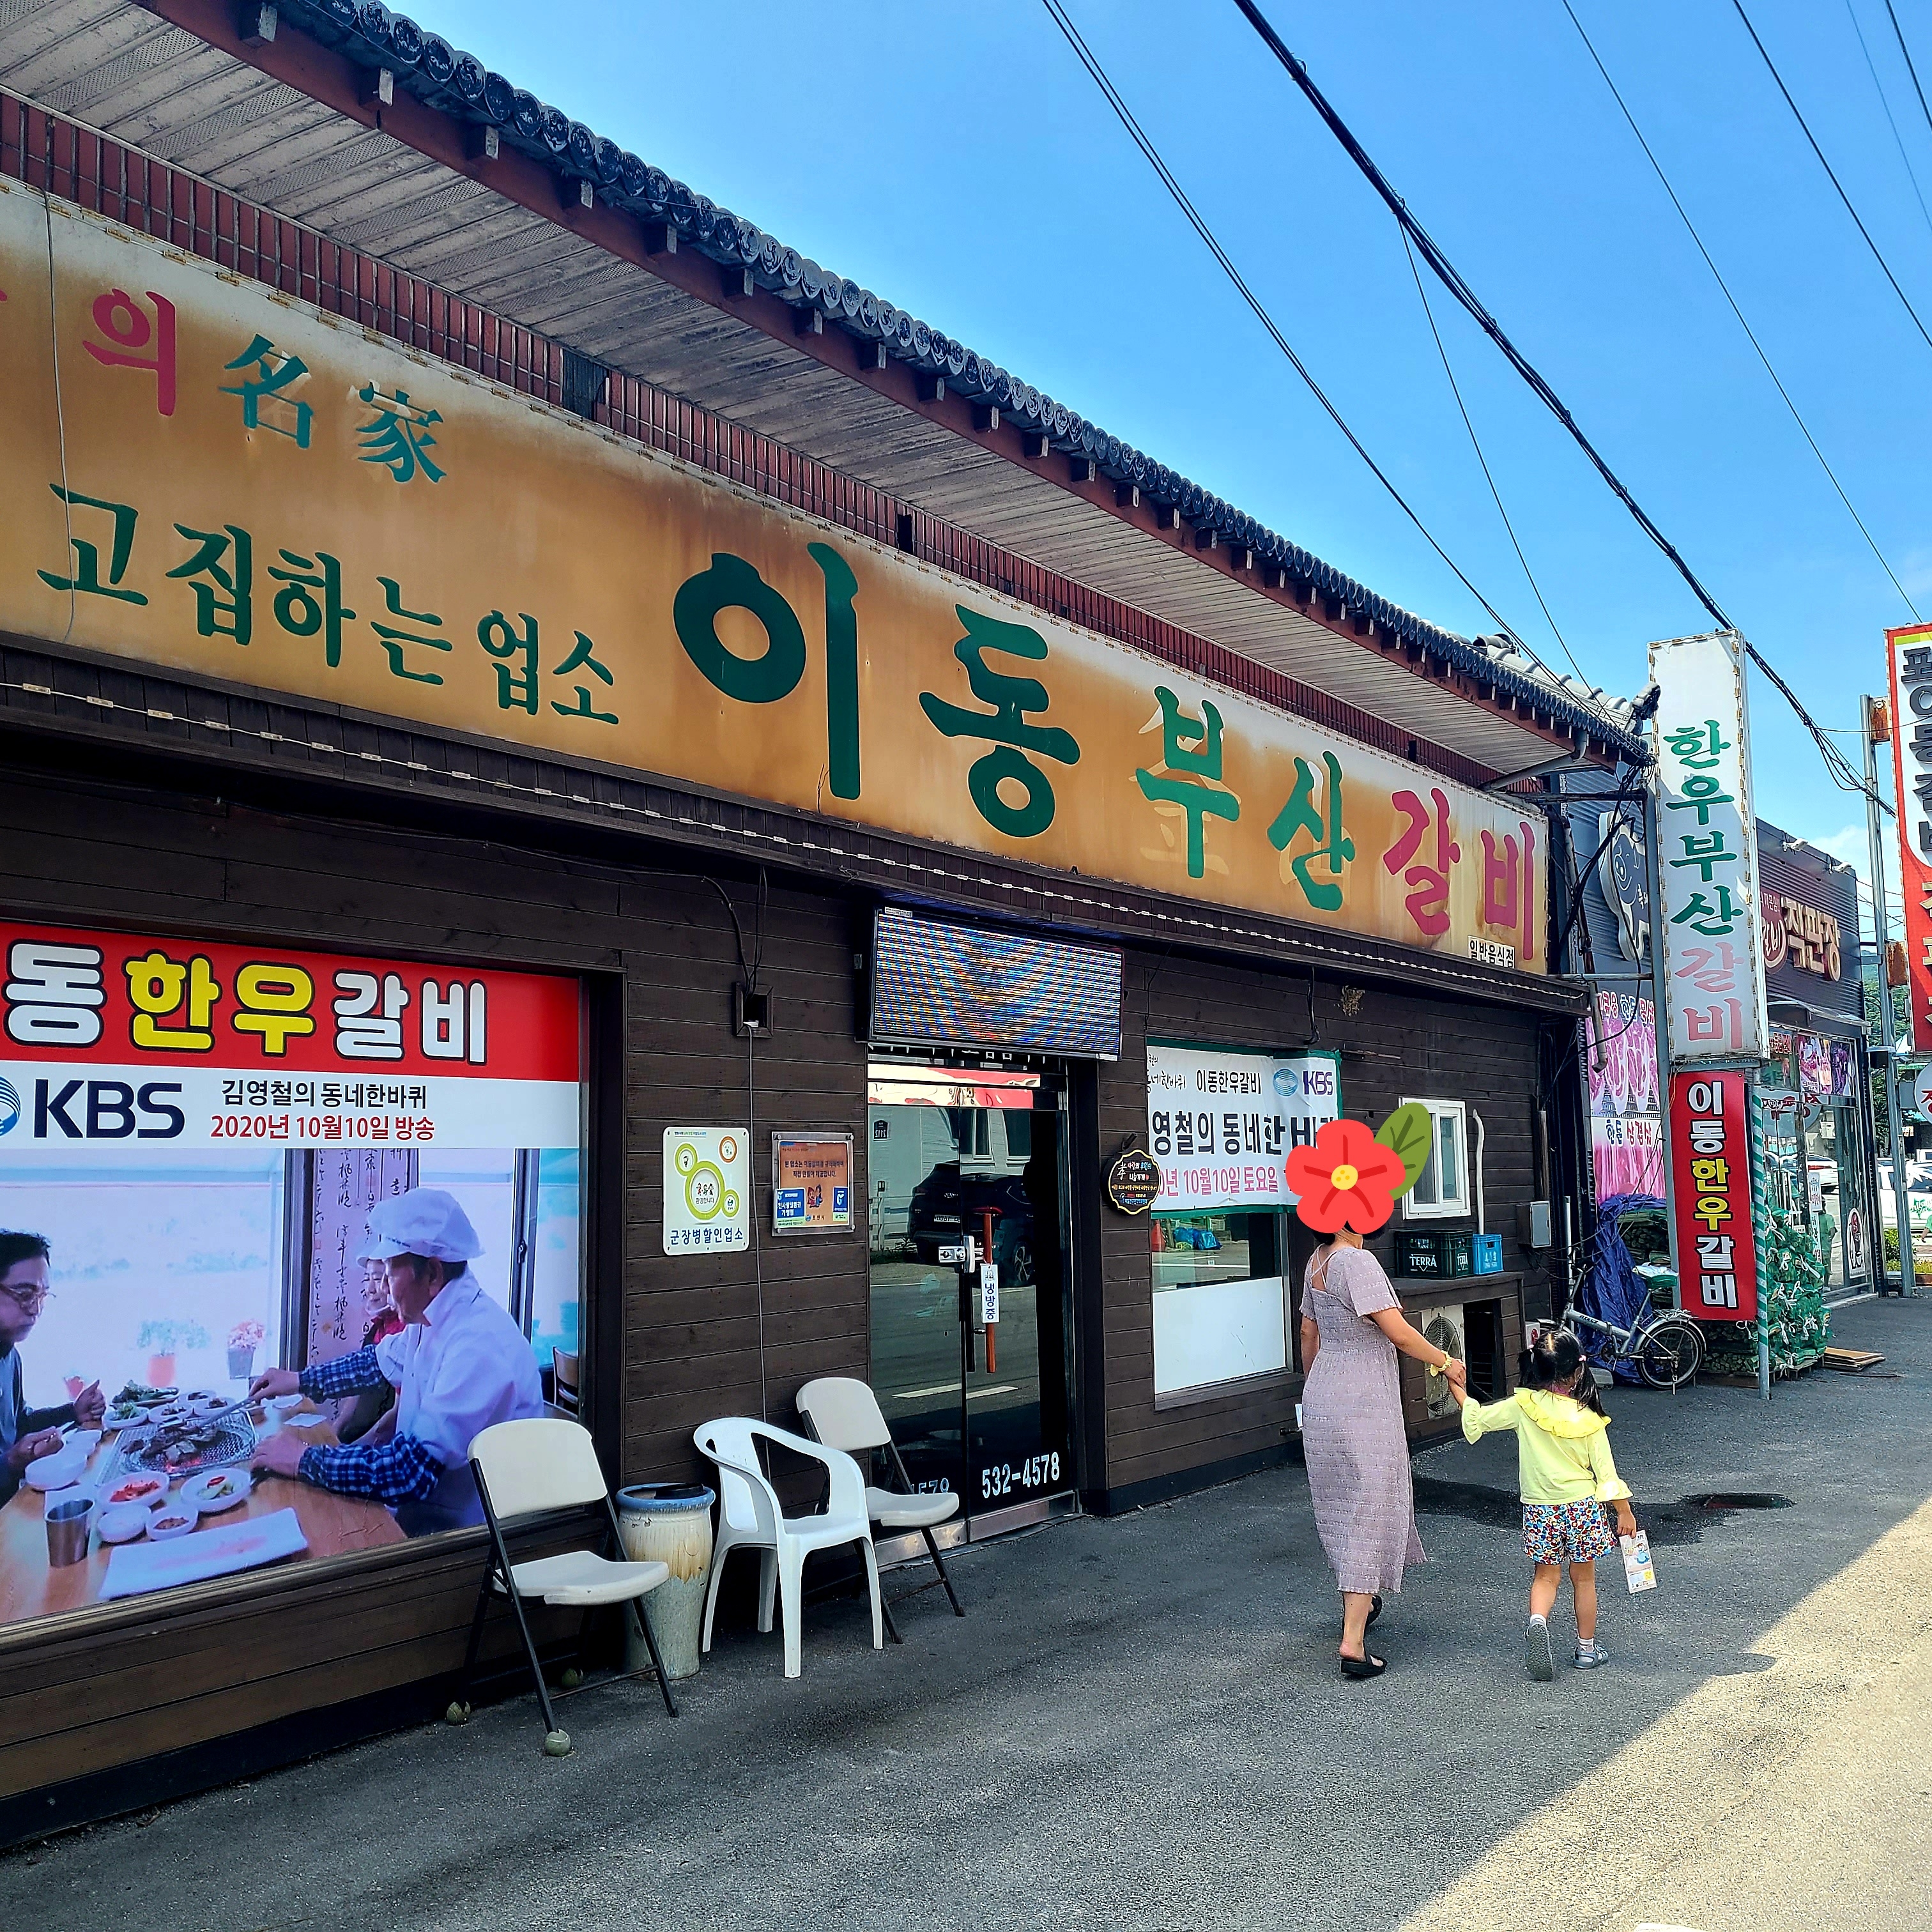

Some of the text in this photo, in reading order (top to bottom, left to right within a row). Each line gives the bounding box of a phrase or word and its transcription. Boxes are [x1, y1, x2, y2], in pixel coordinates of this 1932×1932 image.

[36, 484, 620, 724] 고집하는 업소
[1469, 940, 1514, 968] 일반음식점
[1781, 897, 1841, 983] 직판장
[221, 1080, 427, 1109] 김영철의 동네한바퀴
[1197, 1070, 1261, 1094] 이동한우갈비
[1303, 1071, 1333, 1096] KBS
[34, 1078, 185, 1139] KBS
[210, 1114, 436, 1140] 2020년 10월10일 방송
[1152, 1110, 1335, 1156] 영철의 동네한 바
[1606, 1119, 1652, 1146] 한돈 삼겹살
[1244, 1166, 1278, 1193] 토요일
[1685, 1080, 1738, 1309] 이동한우갈비
[670, 1227, 744, 1245] 군장병할인업소
[1409, 1255, 1438, 1267] TERRA
[985, 1283, 996, 1320] 냉방중
[981, 1452, 1060, 1499] 532-4578
